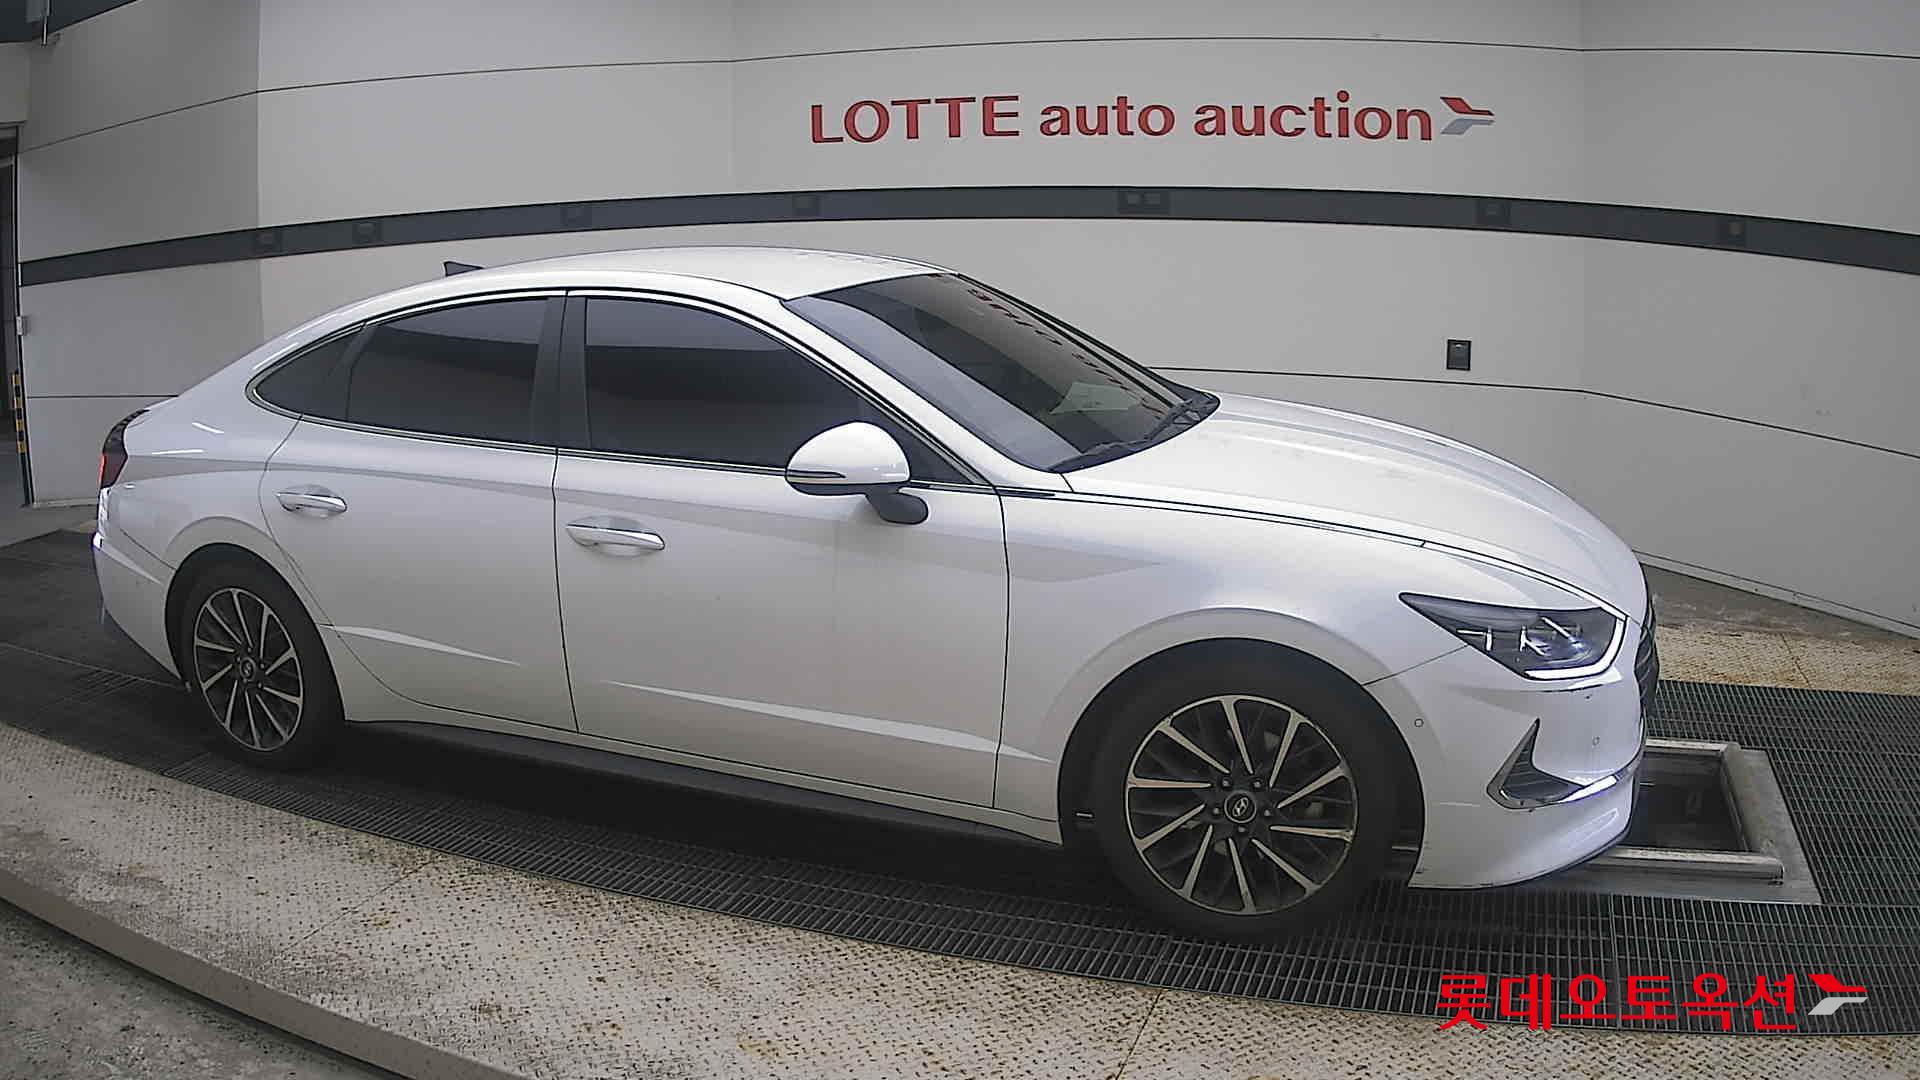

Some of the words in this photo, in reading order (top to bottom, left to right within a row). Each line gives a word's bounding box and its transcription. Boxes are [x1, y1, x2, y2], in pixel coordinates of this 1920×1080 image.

[811, 95, 1020, 144] LOTTE
[1039, 96, 1176, 137] auto
[1193, 90, 1433, 141] auction
